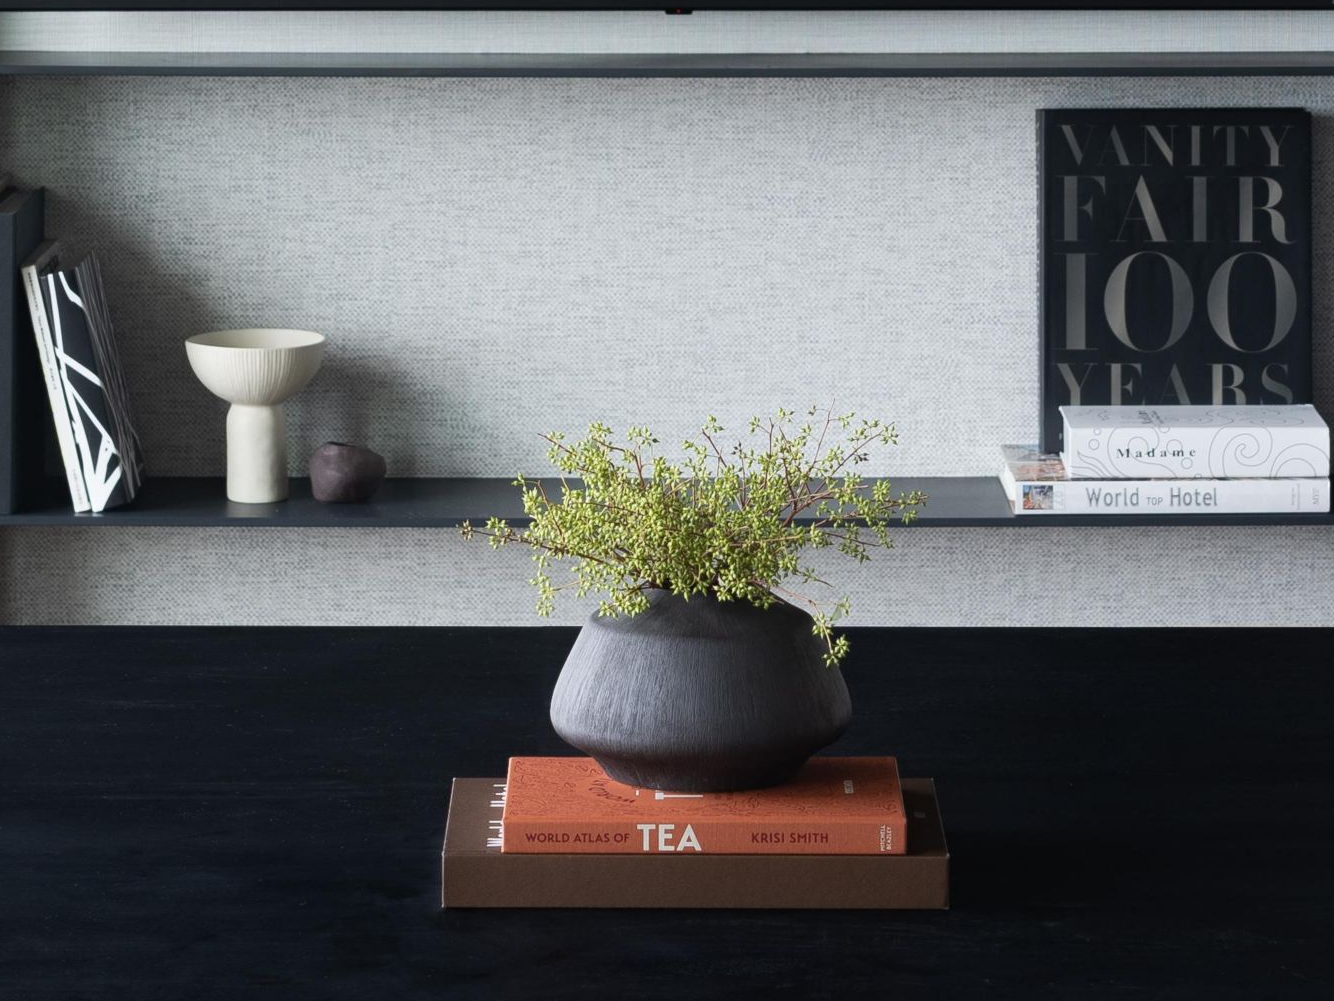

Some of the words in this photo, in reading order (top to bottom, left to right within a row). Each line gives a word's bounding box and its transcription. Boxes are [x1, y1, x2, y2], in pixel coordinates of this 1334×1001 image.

[1055, 124, 1295, 167] VANITY
[1054, 174, 1297, 245] FAIR
[1053, 250, 1298, 354] 100
[1051, 362, 1293, 406] YEARS
[1116, 446, 1197, 460] Madame
[1086, 487, 1140, 508] World
[1146, 497, 1163, 505] TOP
[1169, 487, 1218, 507] Hotel
[525, 832, 571, 845] WORLD
[573, 832, 612, 845] ATLAS
[614, 832, 631, 845] OF
[636, 823, 702, 852] TEA
[751, 832, 786, 845] KRISI
[789, 832, 829, 845] SMITH
